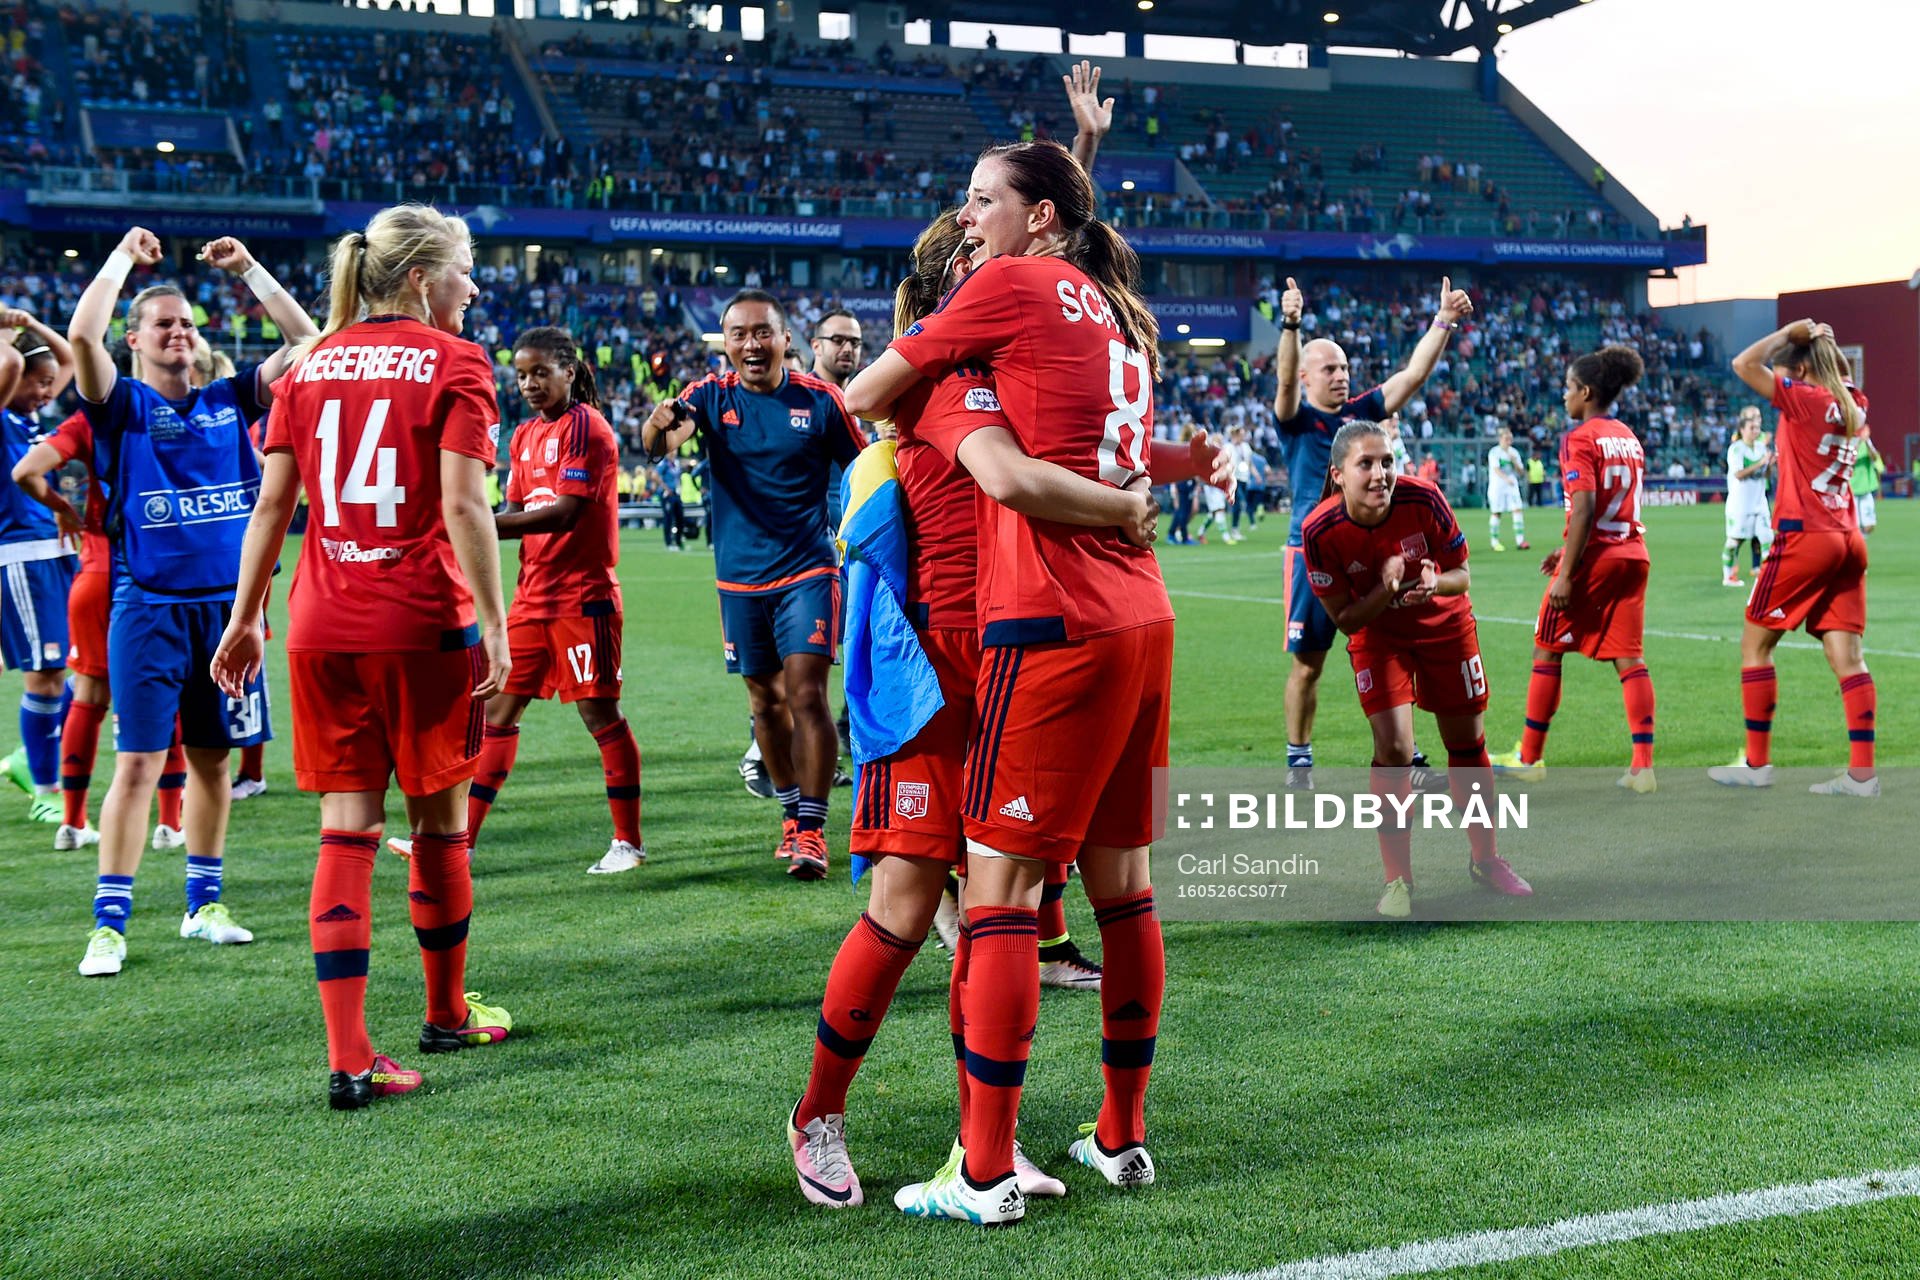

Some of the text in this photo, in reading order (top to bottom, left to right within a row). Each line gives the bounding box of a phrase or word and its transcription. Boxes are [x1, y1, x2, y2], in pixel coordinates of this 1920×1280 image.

[610, 217, 842, 237] UEFA WOMEN'S CHAMPIONS LEAGUE
[1174, 234, 1223, 247] REGGIO
[1224, 236, 1265, 248] EMILIA
[1493, 242, 1522, 254] UEFA
[1570, 244, 1627, 257] CHAMPIONS
[1628, 246, 1664, 258] LEAGUE
[295, 345, 437, 384] HEGERBERG
[1097, 338, 1150, 488] 8
[315, 399, 406, 528] 14
[567, 643, 593, 684] 12
[1461, 654, 1486, 699] 19
[227, 691, 262, 739] 30
[999, 807, 1034, 822] adidas
[1118, 1169, 1153, 1182] adidas
